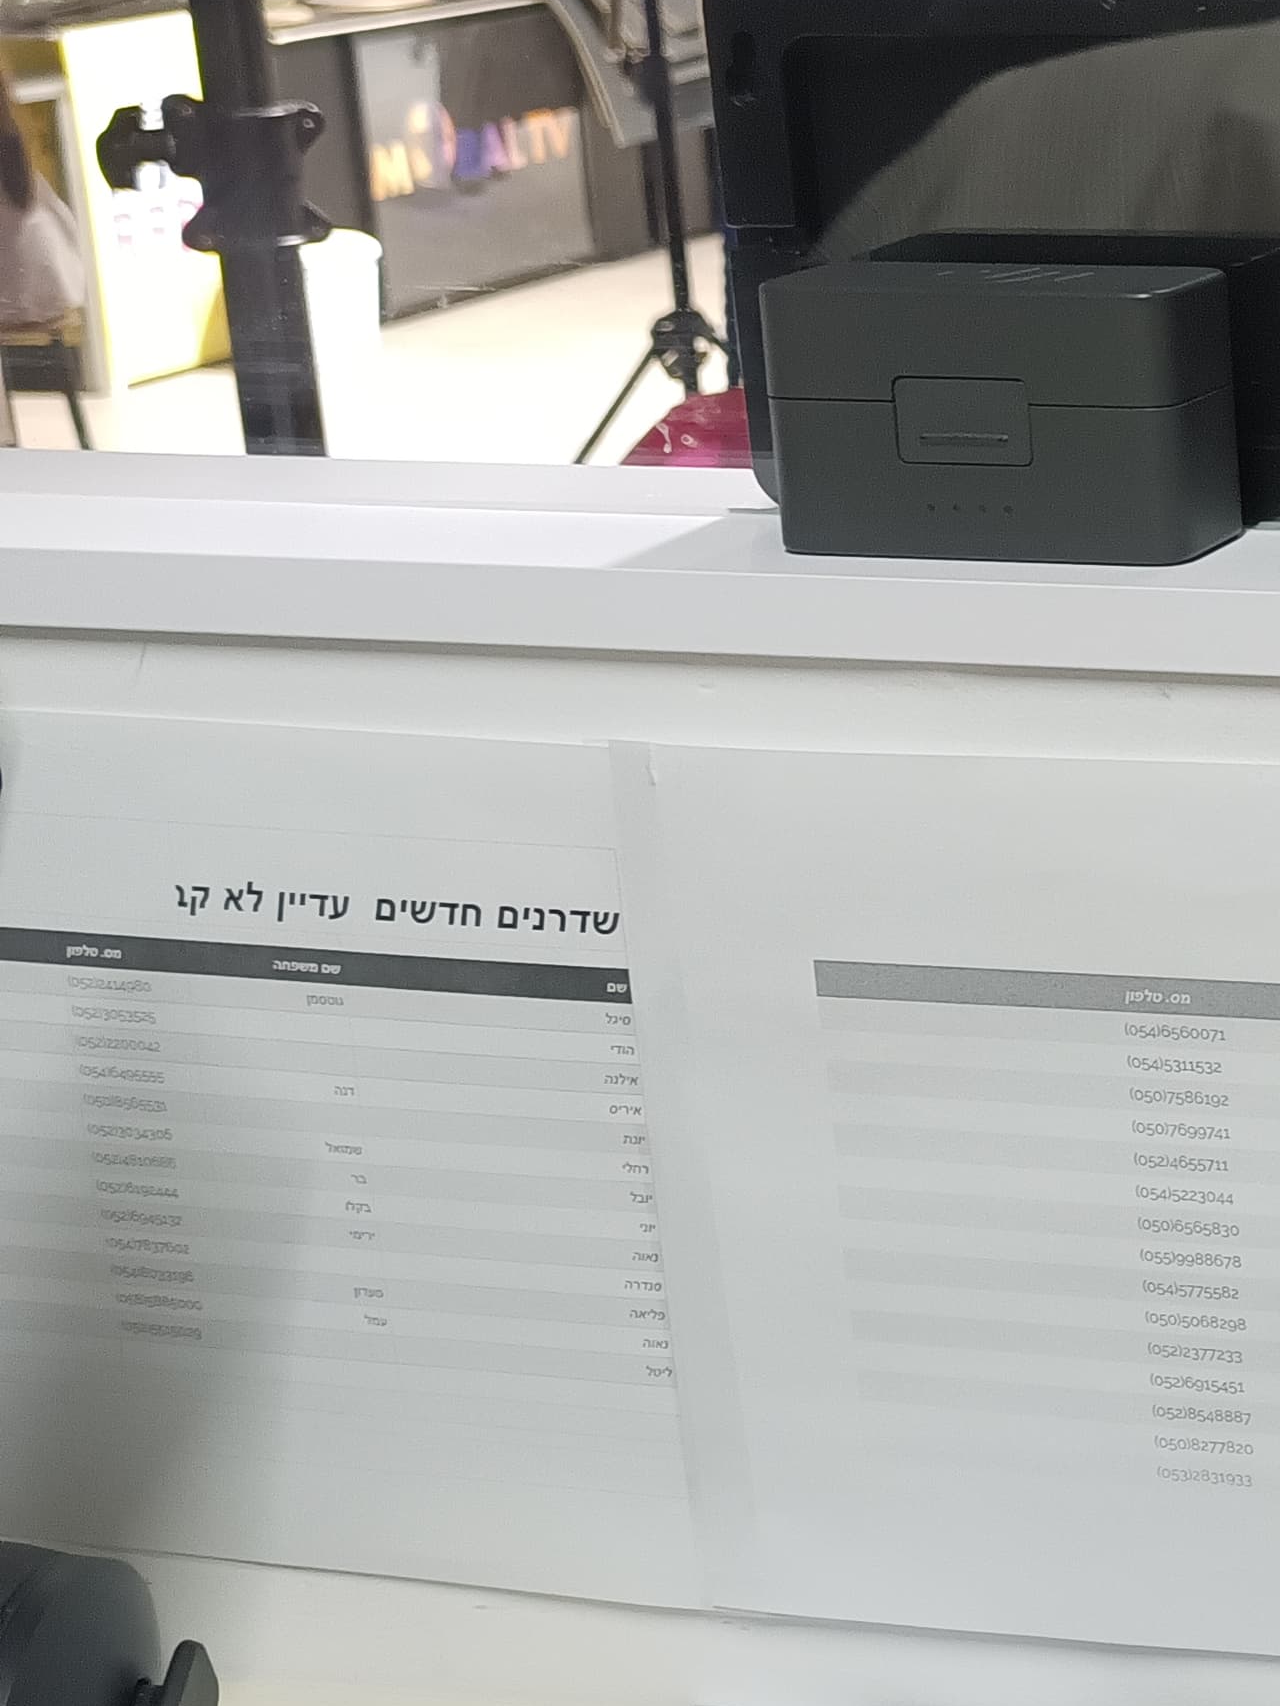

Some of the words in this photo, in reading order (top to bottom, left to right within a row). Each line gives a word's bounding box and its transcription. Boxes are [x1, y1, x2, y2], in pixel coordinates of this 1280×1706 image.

[223, 882, 263, 912] לא
[277, 891, 350, 922] עדיין
[375, 898, 483, 927] חדשים
[497, 904, 620, 935] שדרנים
[66, 945, 98, 958] טלפון
[272, 960, 318, 973] משפחה
[321, 964, 341, 974] שם
[607, 983, 627, 993] שם
[1125, 989, 1163, 1004] טלפון
